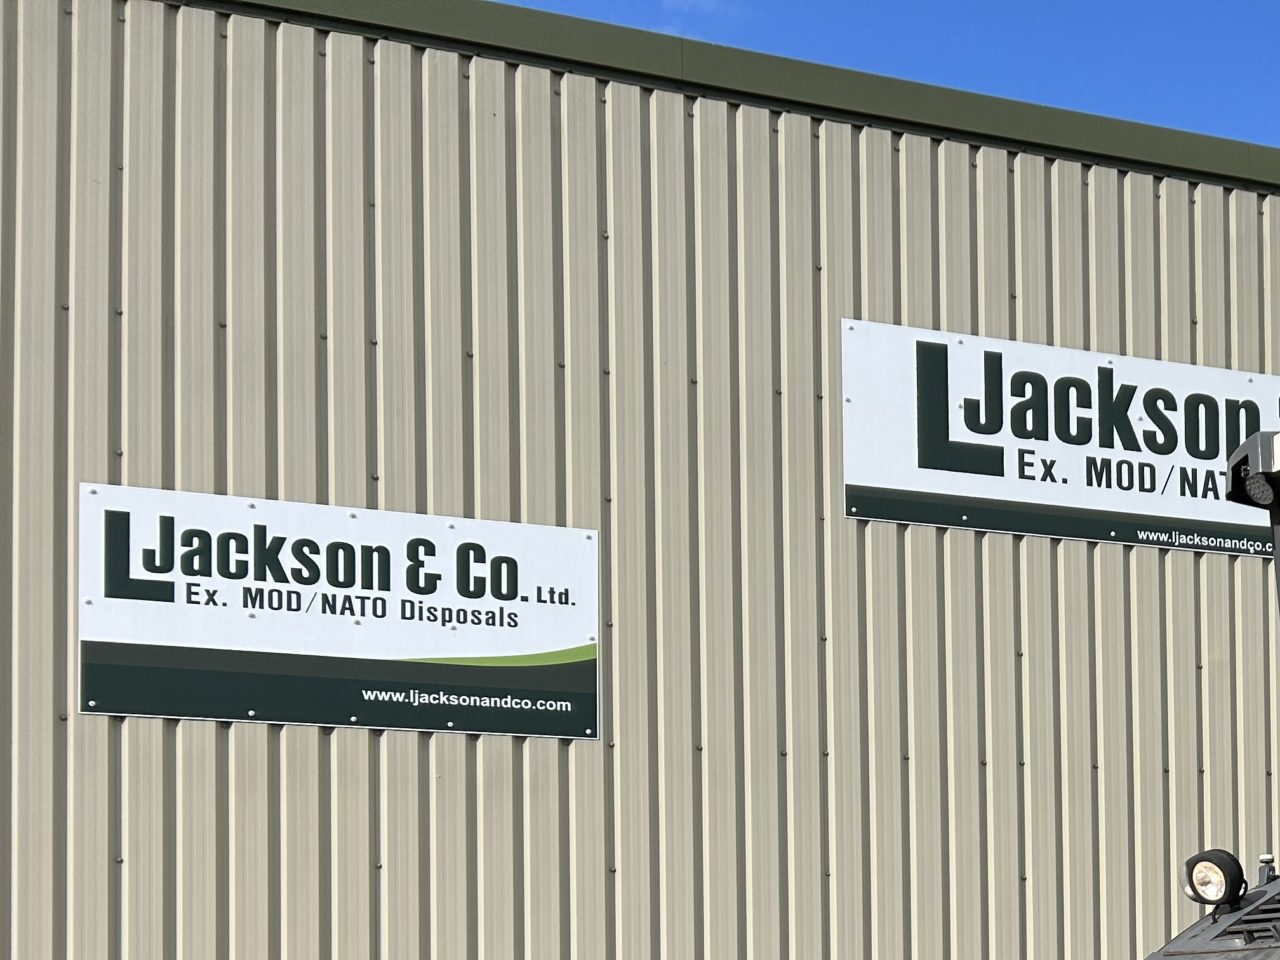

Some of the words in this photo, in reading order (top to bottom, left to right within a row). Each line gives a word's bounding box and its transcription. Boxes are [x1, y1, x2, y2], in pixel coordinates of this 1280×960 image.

[1017, 448, 1068, 485] Ex.
[1085, 455, 1227, 501] MOD/NA
[1136, 530, 1274, 553] www.ljacksonandco.c
[405, 537, 442, 596] &
[456, 542, 529, 604] Co.
[536, 586, 577, 607] Ltd.
[185, 582, 228, 607] Ex.
[242, 586, 387, 619] MOD/NATO
[400, 598, 519, 629] Disposals
[361, 687, 573, 712] www.ljacksonandco.com
